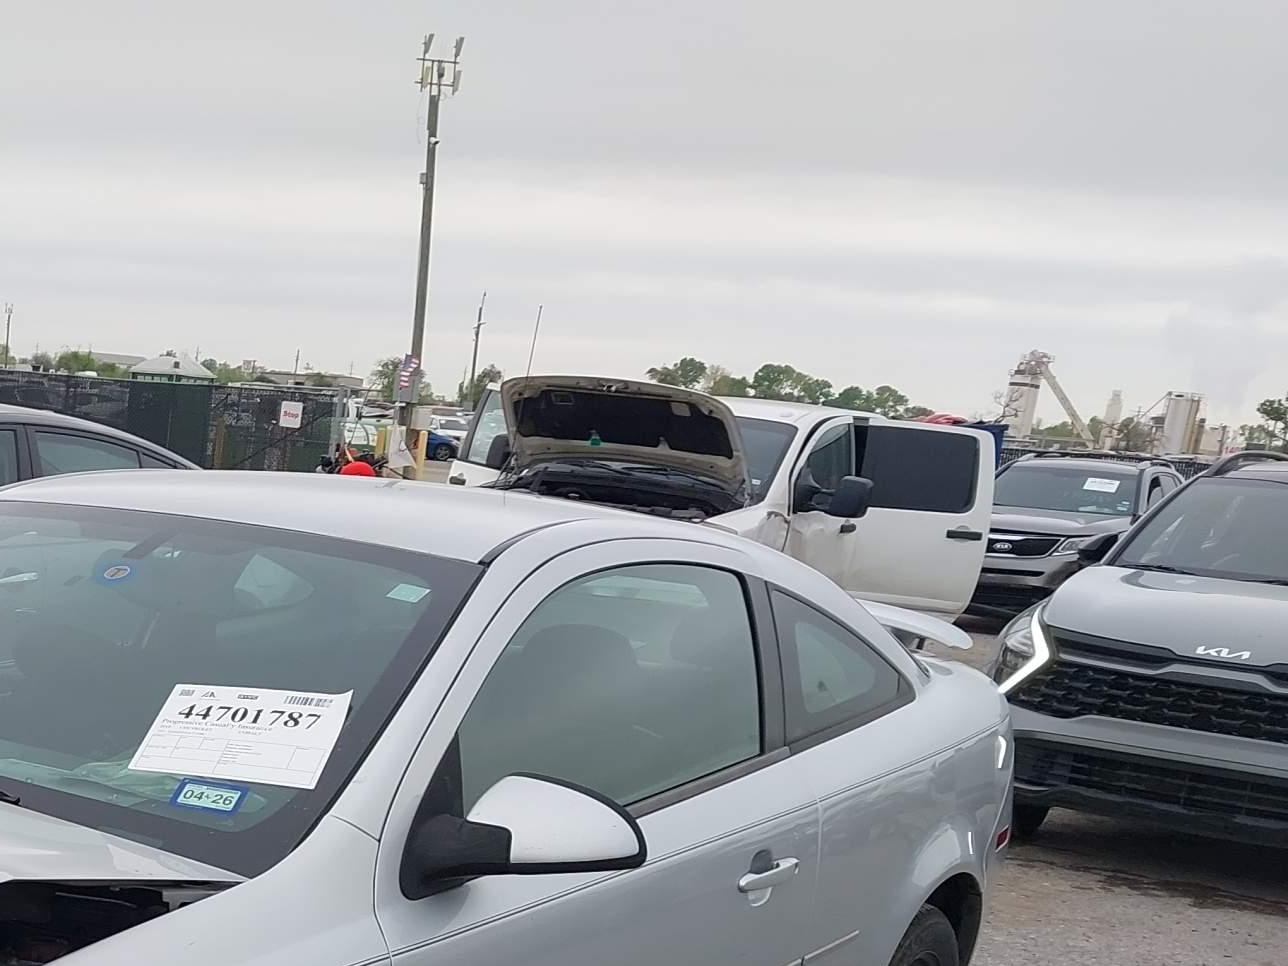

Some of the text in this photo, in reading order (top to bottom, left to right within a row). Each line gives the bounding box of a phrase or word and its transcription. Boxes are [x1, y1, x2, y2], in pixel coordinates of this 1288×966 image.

[282, 410, 299, 419] Stop
[177, 703, 322, 730] 44701787
[183, 789, 235, 806] 04 26
